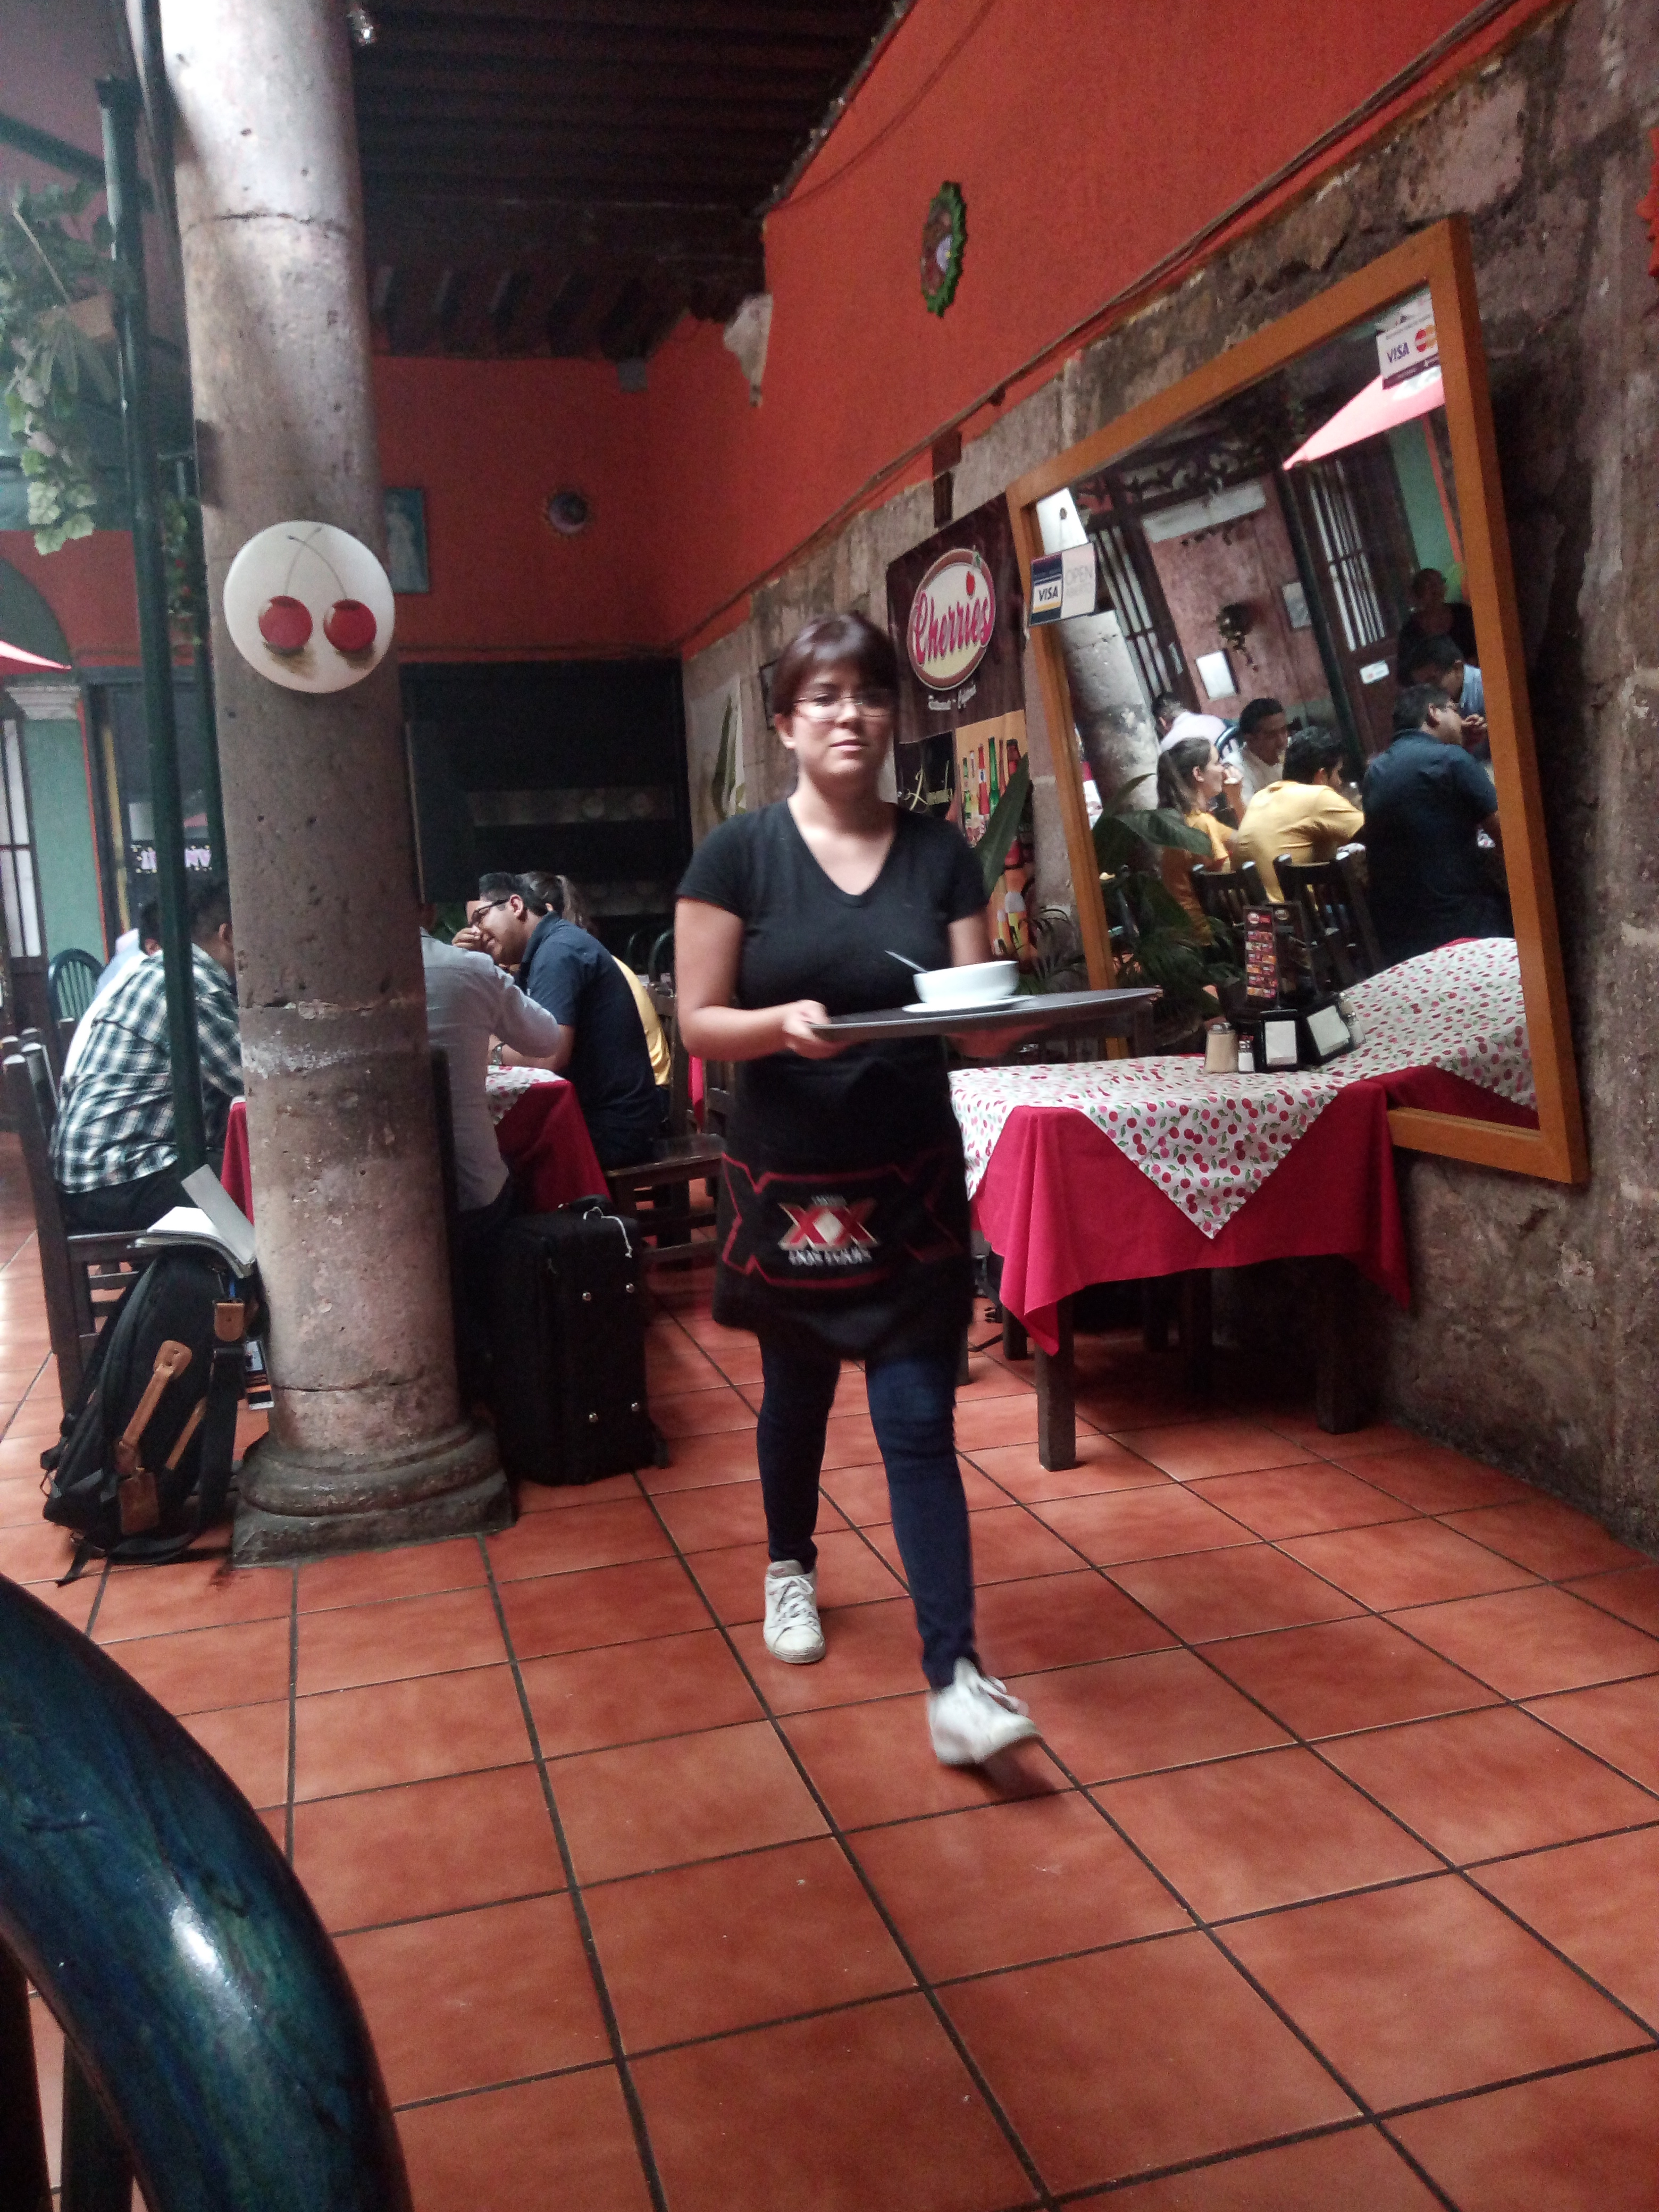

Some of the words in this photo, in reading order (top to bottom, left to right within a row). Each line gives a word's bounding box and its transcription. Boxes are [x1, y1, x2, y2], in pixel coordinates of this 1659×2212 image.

[1386, 342, 1410, 363] VISA
[1038, 585, 1058, 601] VISA
[778, 1197, 880, 1250] XX
